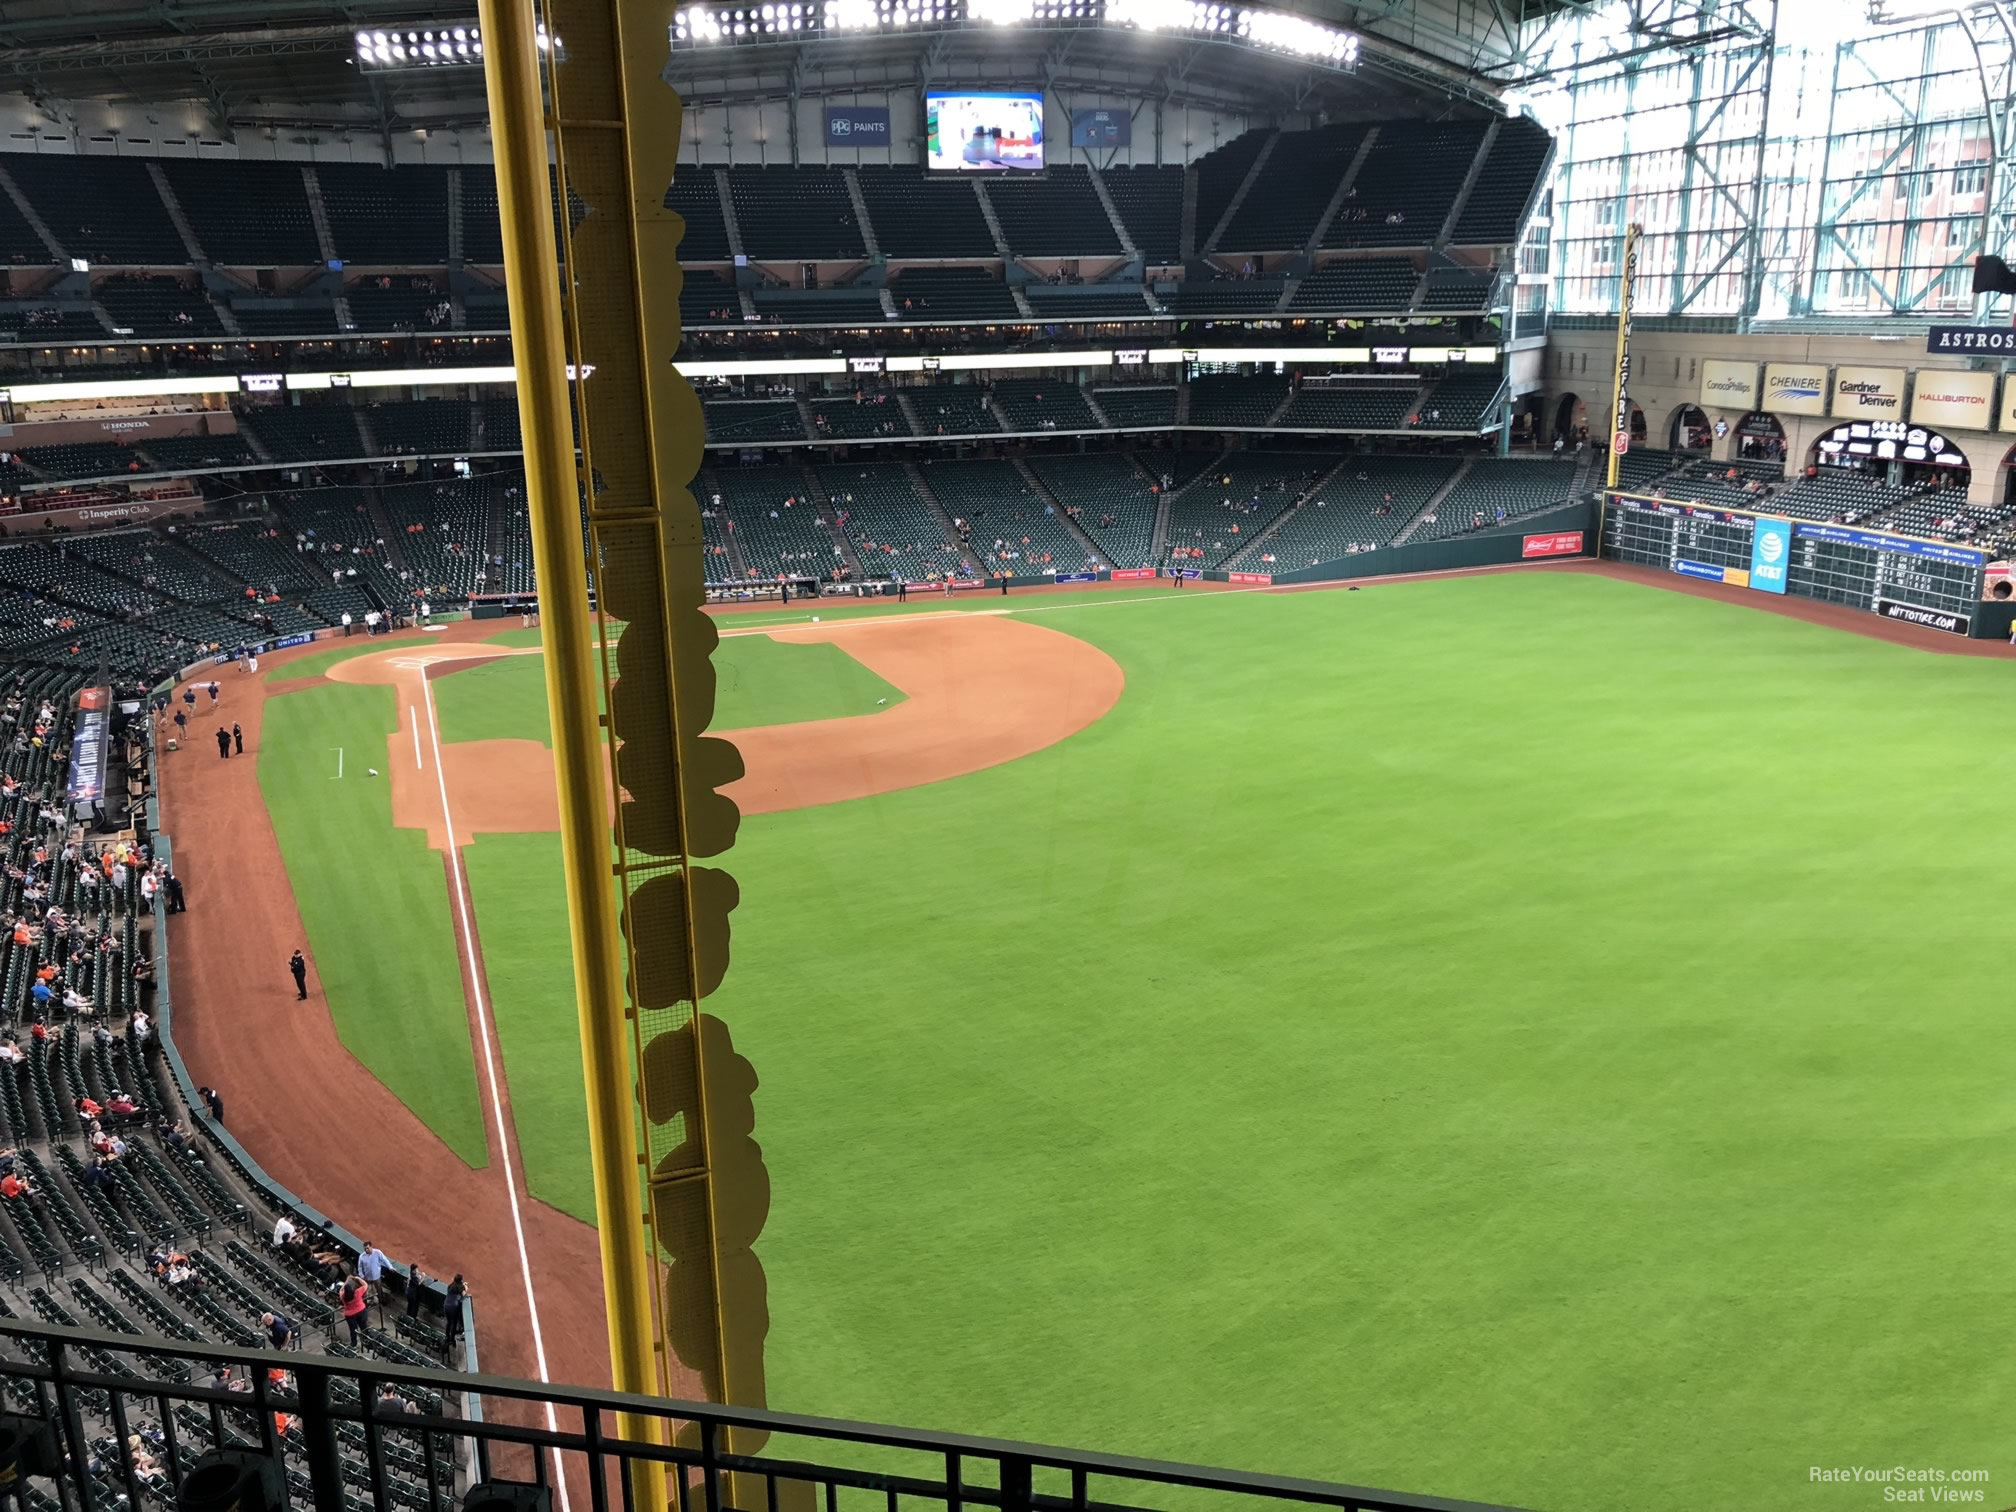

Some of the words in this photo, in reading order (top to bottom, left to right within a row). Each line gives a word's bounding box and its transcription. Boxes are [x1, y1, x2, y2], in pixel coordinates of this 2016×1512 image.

[832, 120, 849, 134] PPG
[854, 122, 885, 132] PAINTS
[1939, 333, 2016, 348] ASTROS
[1706, 380, 1751, 393] ConocoPhillips
[1770, 376, 1822, 390] CHENIERE
[1839, 380, 1880, 393] Gardner
[1859, 394, 1897, 408] Denver
[1919, 393, 1986, 404] HALLIBURTON
[111, 421, 150, 429] HONDA
[1620, 498, 1640, 508] Fanatics
[1659, 504, 1680, 514] Fanatics
[90, 508, 129, 519] Insperity
[130, 505, 150, 514] Club
[1692, 509, 1715, 520] Fanatics
[1731, 515, 1754, 526] Fanatics
[1801, 526, 1820, 534] UNITED
[1826, 530, 1851, 538] AIRLINES
[1861, 535, 1880, 543] UNITED
[1885, 540, 1910, 549] AIRLINES
[1922, 546, 1943, 554] UNITED
[1948, 551, 1975, 560] AIRLINES
[1754, 564, 1783, 580] AT&T
[1888, 605, 1957, 631] NITTOTIRE.COM
[278, 638, 303, 646] UNITED
